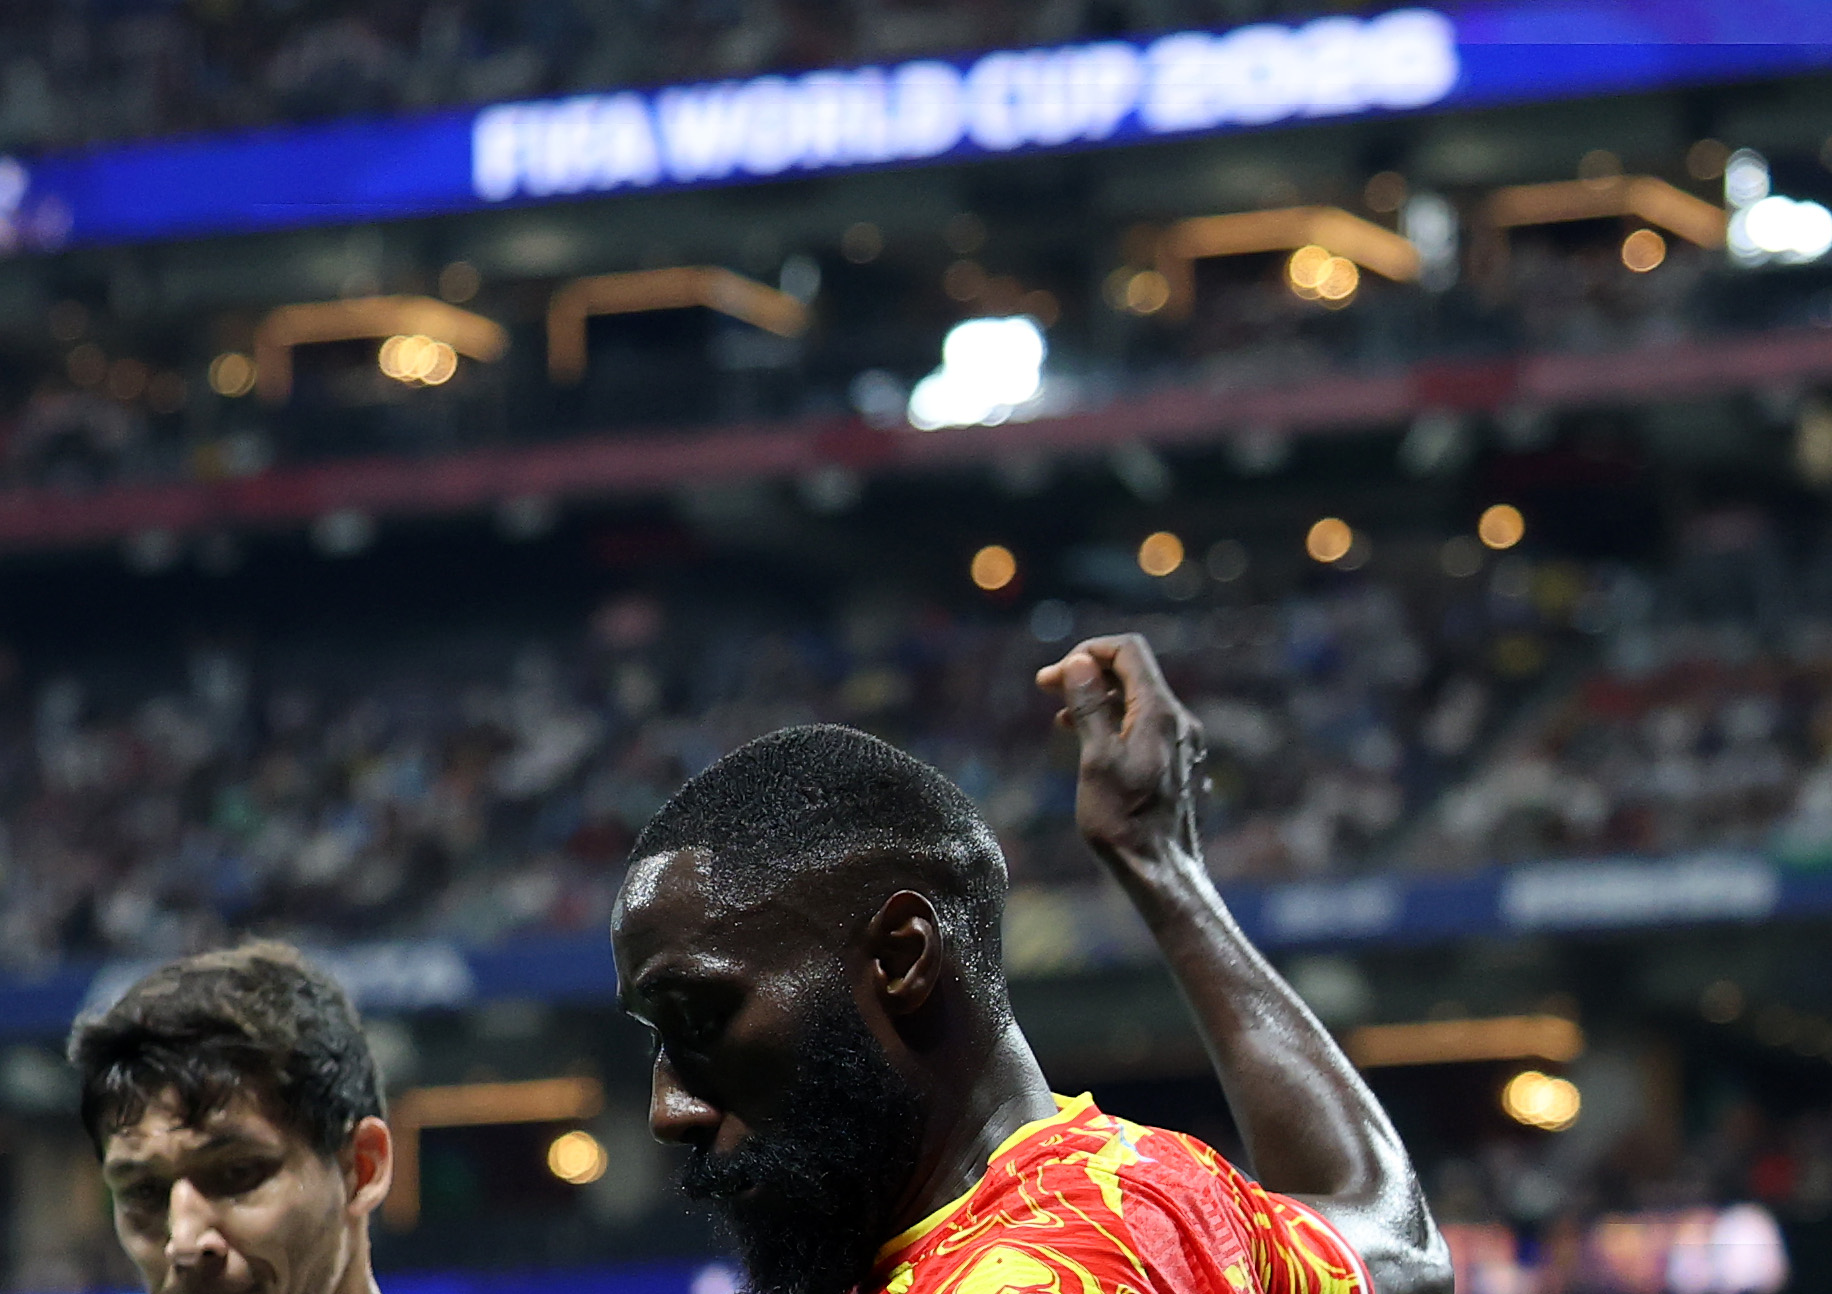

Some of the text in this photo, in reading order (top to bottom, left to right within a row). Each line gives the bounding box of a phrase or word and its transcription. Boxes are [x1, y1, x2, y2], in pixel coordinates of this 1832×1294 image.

[471, 92, 660, 202] FIFA
[658, 60, 966, 183] WORLD
[966, 40, 1144, 153] CUP
